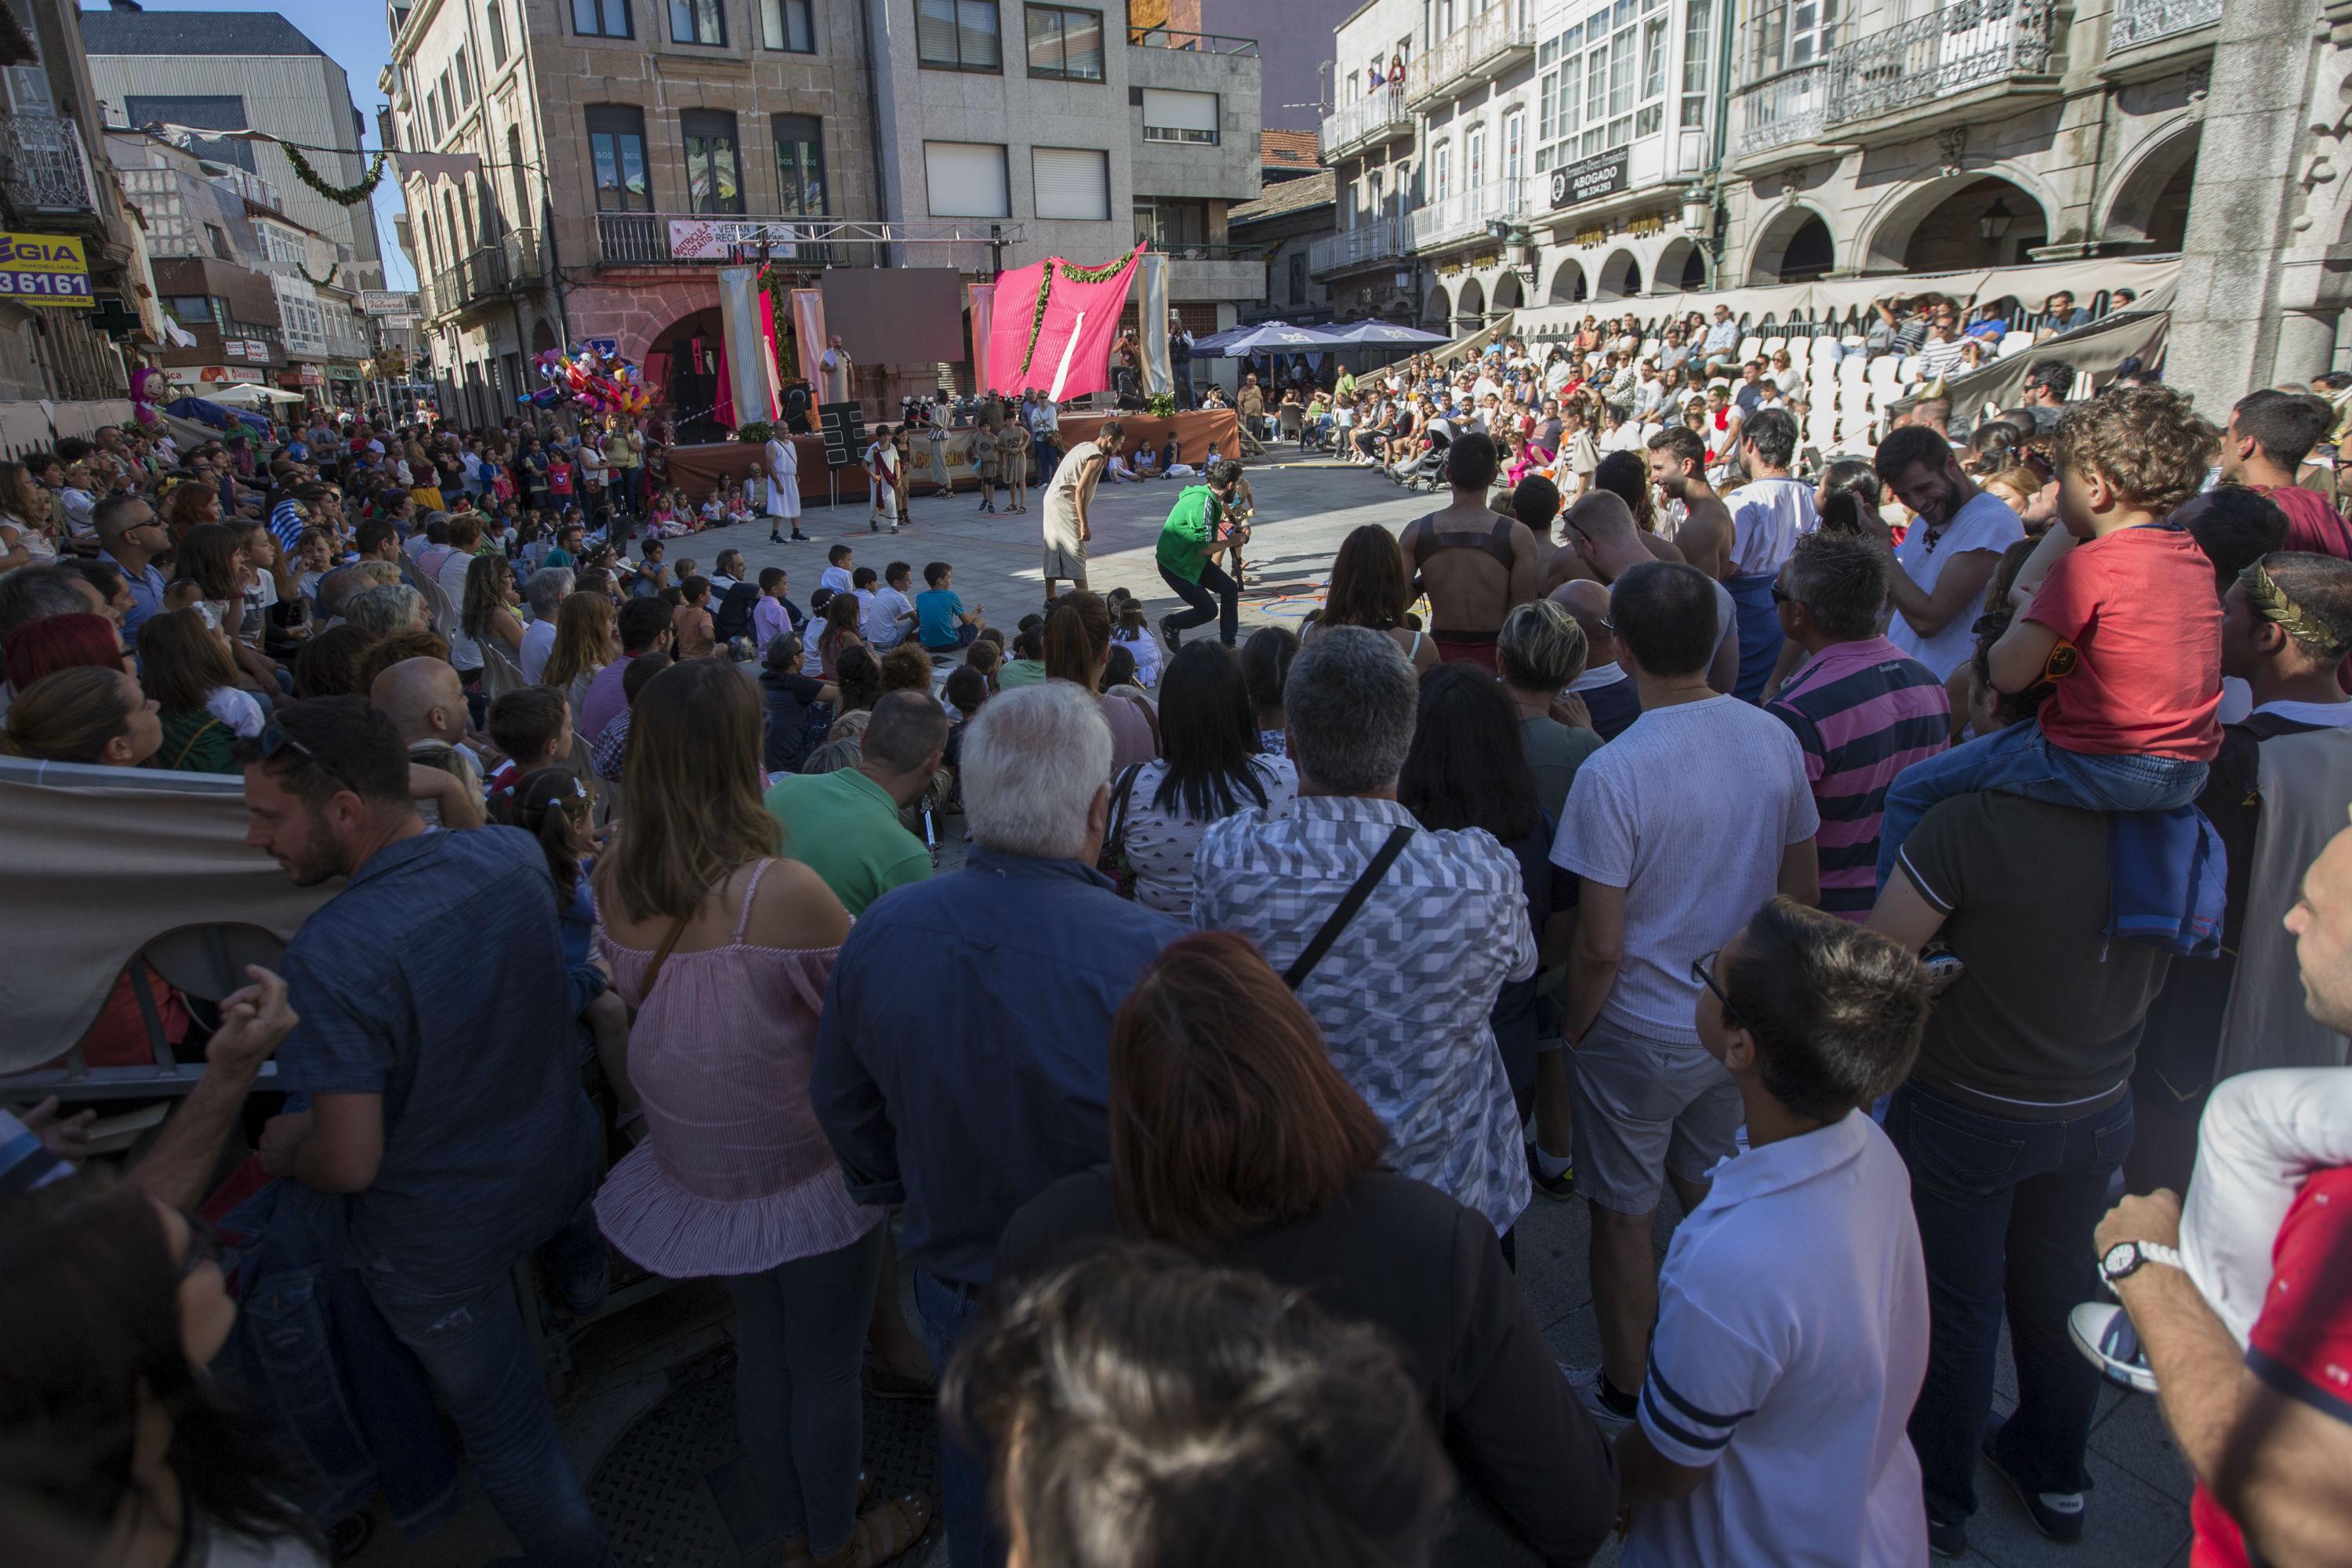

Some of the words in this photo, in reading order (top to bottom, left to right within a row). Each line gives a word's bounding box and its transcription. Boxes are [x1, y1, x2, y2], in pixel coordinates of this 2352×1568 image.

[1572, 165, 1618, 190] ABOGADO
[688, 232, 713, 257] GRATIS
[23, 295, 88, 303] inmobiliaria.es
[368, 299, 405, 309] Valverde
